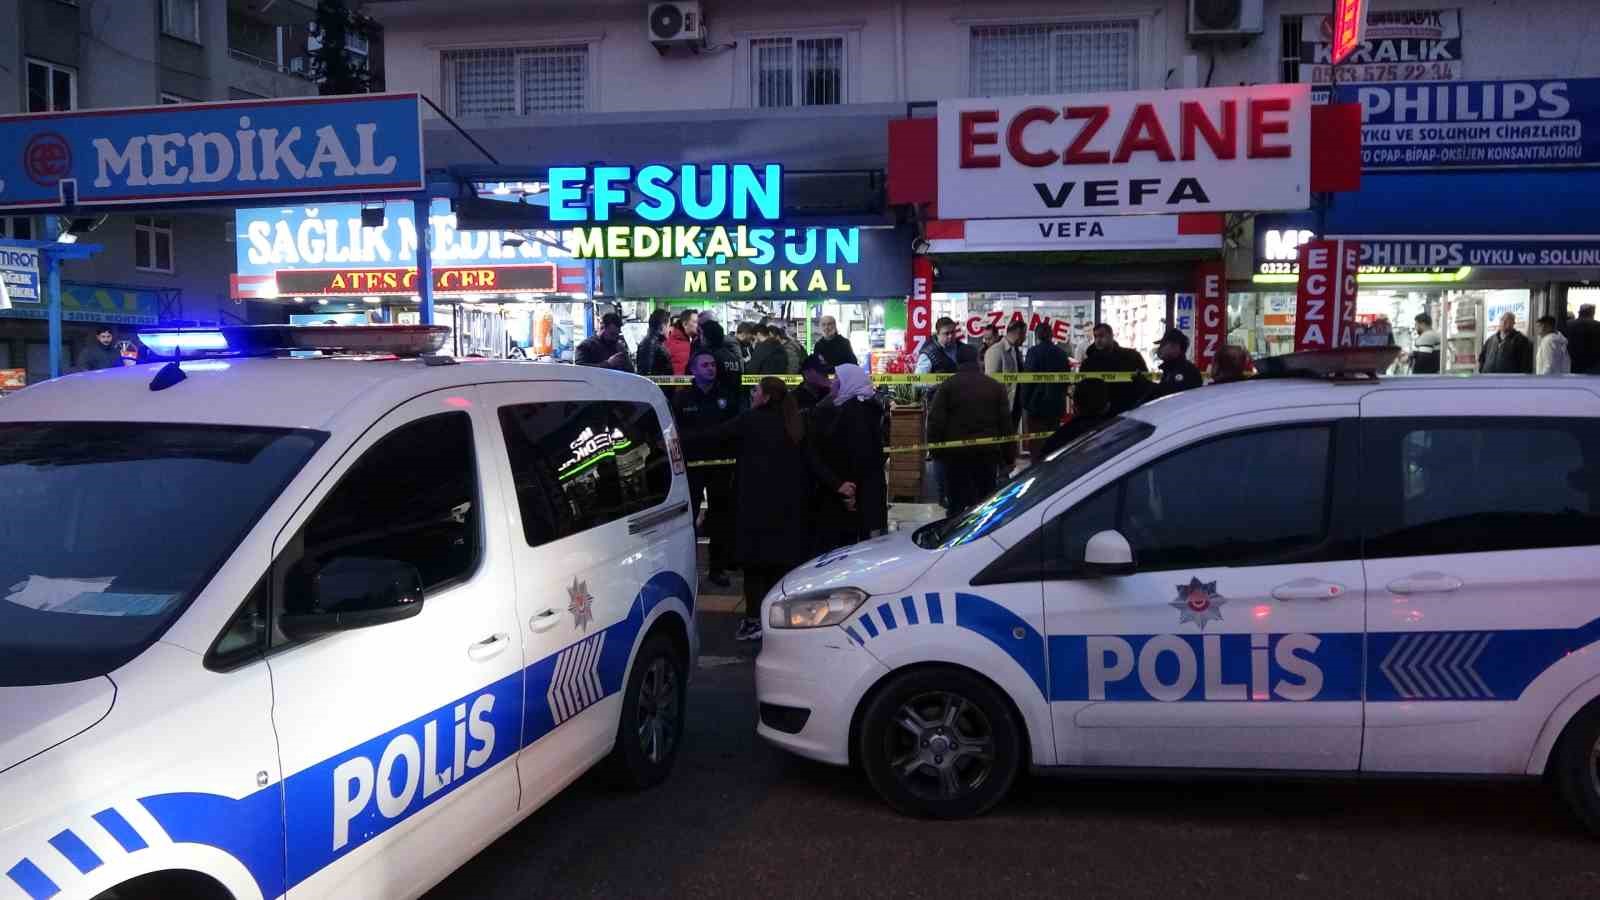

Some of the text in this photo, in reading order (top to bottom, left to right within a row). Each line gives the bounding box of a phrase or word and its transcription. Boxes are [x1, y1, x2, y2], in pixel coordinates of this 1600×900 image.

[1314, 39, 1452, 63] KRALIK
[1358, 82, 1570, 123] PHILIPS
[92, 115, 397, 189] MEDİKAL
[959, 98, 1292, 169] ECZANE
[1395, 128, 1414, 141] VE
[1420, 126, 1490, 141] SOLUNUM
[1496, 122, 1577, 138] CİHAZLARI
[548, 163, 781, 221] EFSUN
[1033, 177, 1210, 208] VEFA
[248, 207, 392, 265] SAĞLIK
[1038, 221, 1105, 239] VEFA
[1260, 262, 1291, 274] 0322
[1360, 243, 1463, 266] PHILIPS
[1469, 250, 1514, 266] UYKU
[1518, 252, 1536, 265] ve
[1087, 631, 1324, 702] POLİS
[332, 693, 496, 851] POLİS
